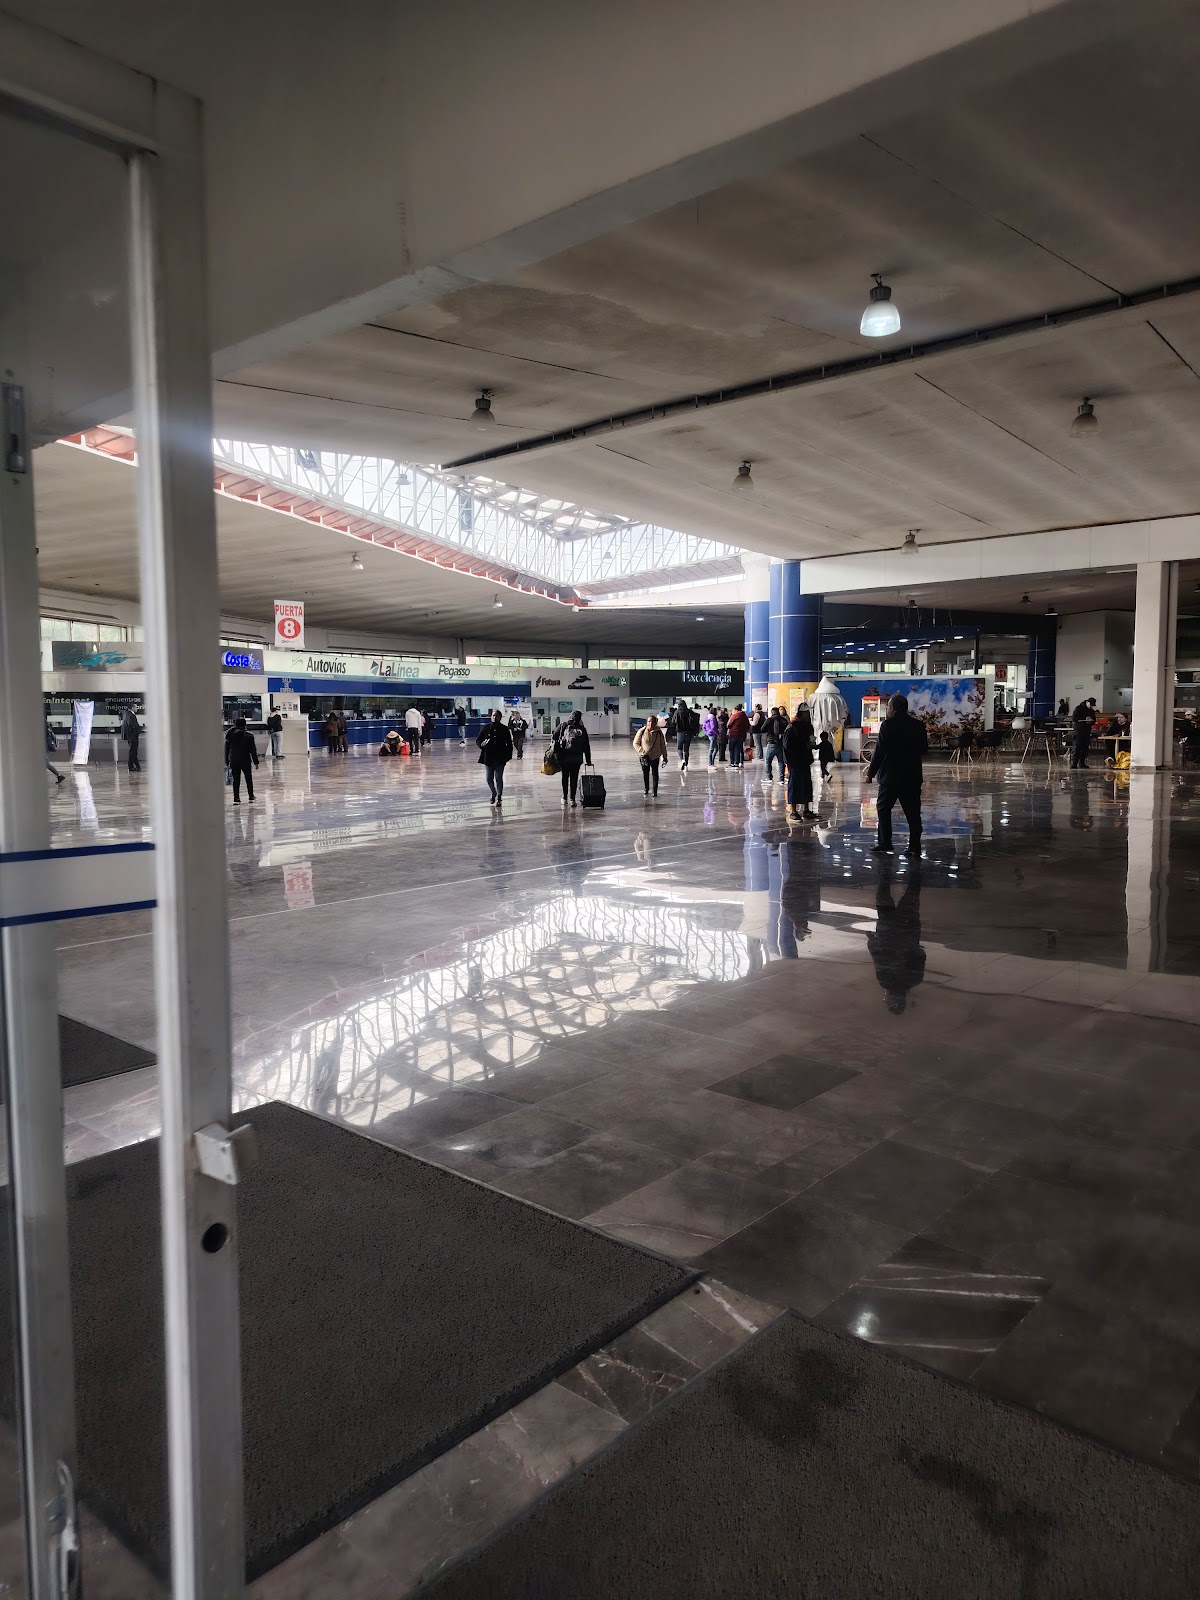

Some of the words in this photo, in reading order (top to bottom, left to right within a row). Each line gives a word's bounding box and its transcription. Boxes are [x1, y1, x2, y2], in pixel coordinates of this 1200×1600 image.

[275, 604, 303, 617] PUERTA
[283, 620, 296, 637] 8
[222, 651, 249, 667] Costa
[306, 657, 347, 674] Autovías
[438, 664, 471, 679] Pegasso
